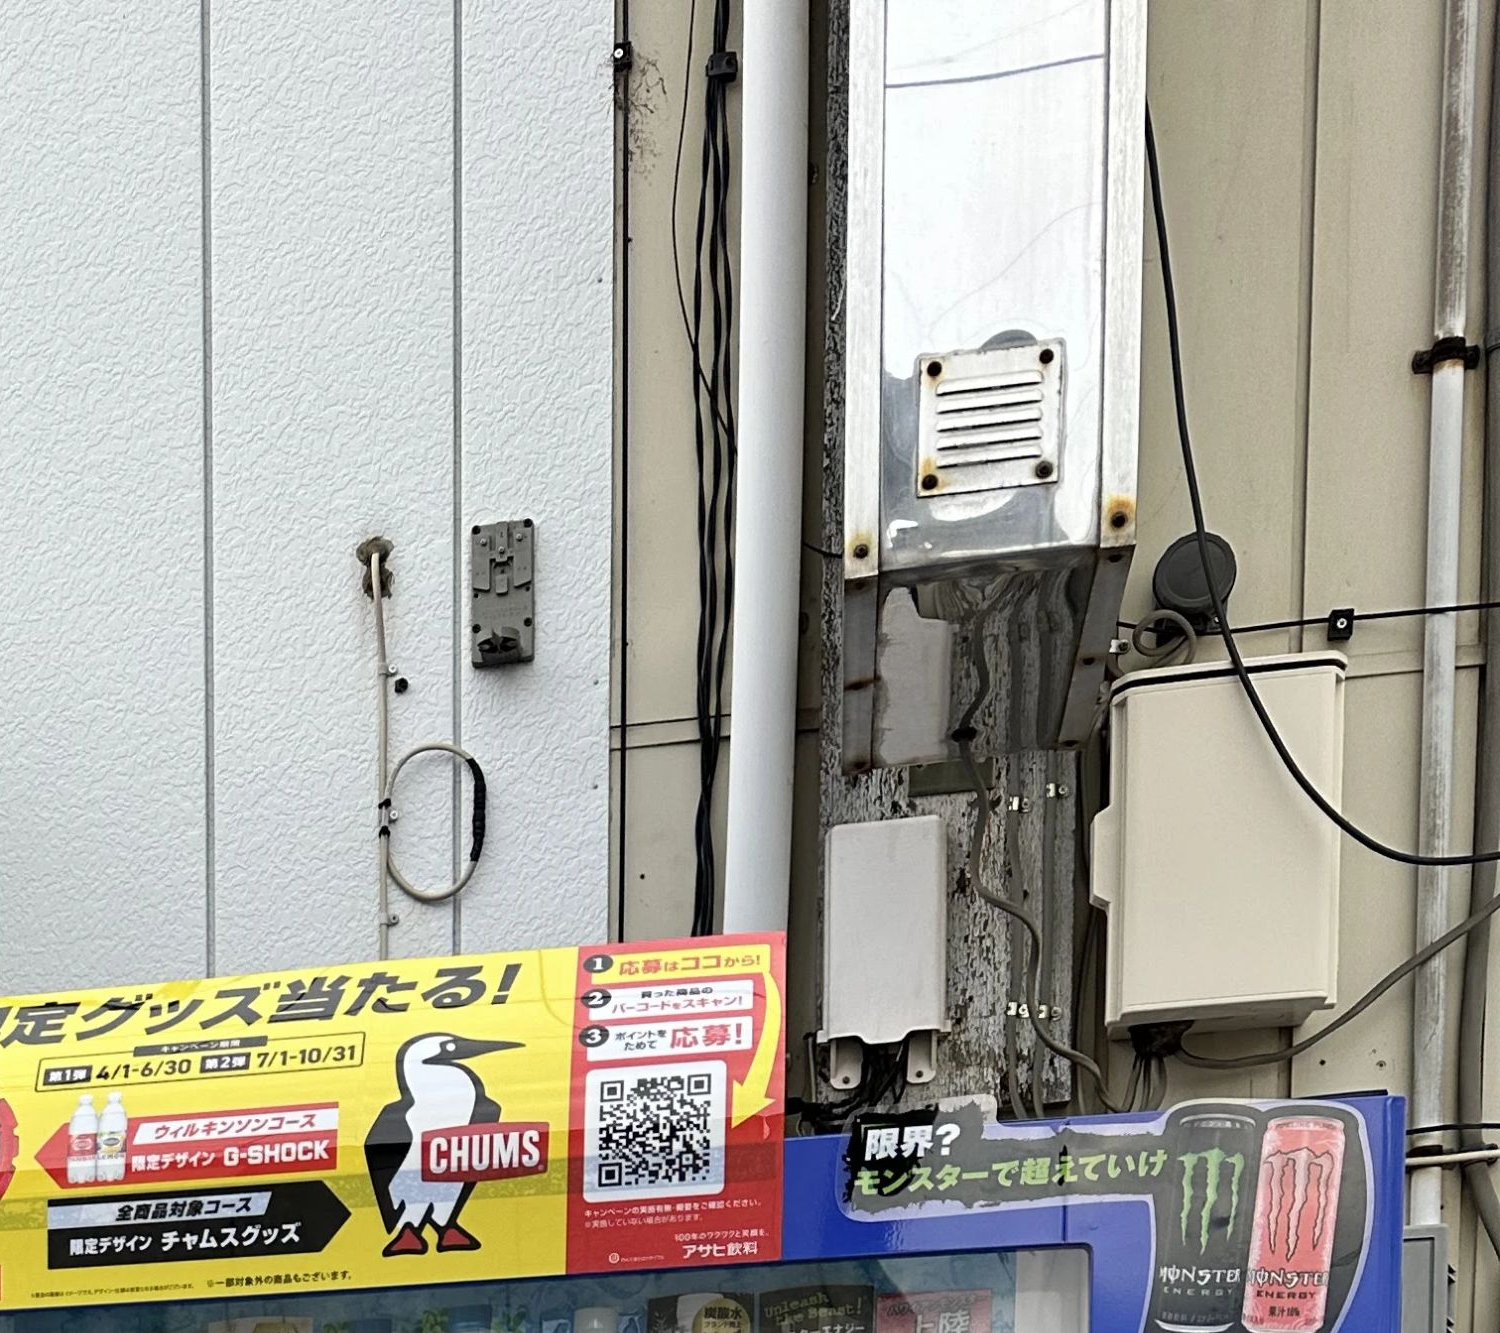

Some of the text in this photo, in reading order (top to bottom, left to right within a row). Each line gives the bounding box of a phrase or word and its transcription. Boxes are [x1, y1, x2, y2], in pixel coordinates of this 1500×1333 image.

[619, 955, 761, 976] 応募はココから!
[670, 1023, 742, 1049] 応募!
[96, 1058, 191, 1081] 4/1-6/30
[257, 1045, 356, 1069] 7/1-10/31
[154, 1115, 316, 1139] ウィルキンソンコース
[864, 1123, 959, 1161] 限界?
[131, 1139, 329, 1171] 限定デザイン G-SHOCK
[430, 1130, 540, 1174] CHUMS
[854, 1149, 1167, 1197] モンスターで超えていけ
[116, 1198, 254, 1221] 全商品対象コース
[69, 1222, 301, 1255] 限定デザイン チャムスグッズ
